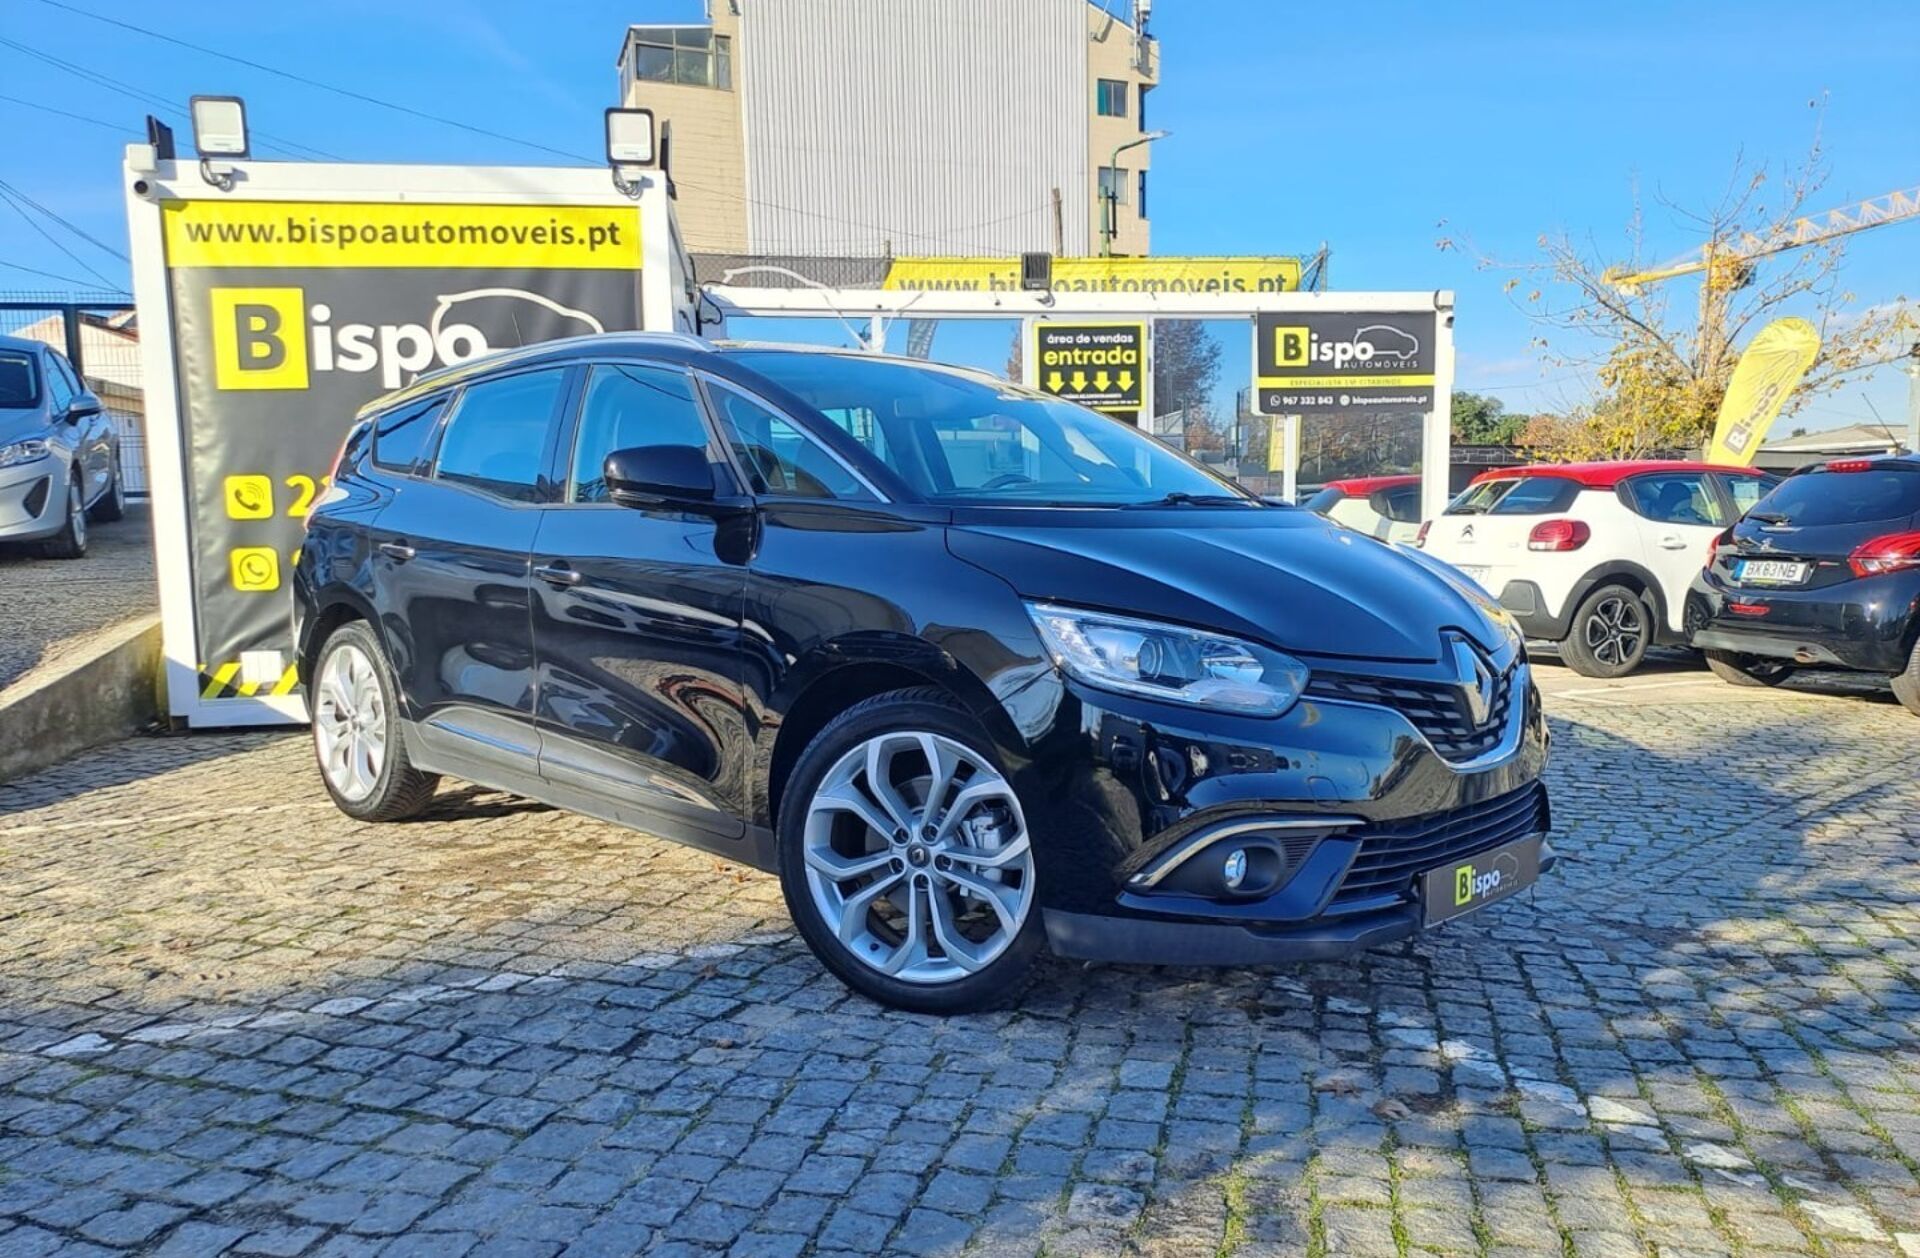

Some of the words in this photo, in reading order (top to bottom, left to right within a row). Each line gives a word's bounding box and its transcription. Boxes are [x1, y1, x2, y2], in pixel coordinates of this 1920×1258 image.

[185, 217, 622, 251] www.bispoautomoveis.pt
[233, 303, 488, 389] Bispo
[1043, 345, 1137, 366] entrada
[1047, 333, 1074, 344] área
[1076, 333, 1091, 344] de
[1092, 333, 1134, 344] vendas
[1283, 332, 1375, 369] Bispo
[285, 474, 332, 518] 2
[1459, 868, 1501, 899] Bispo
